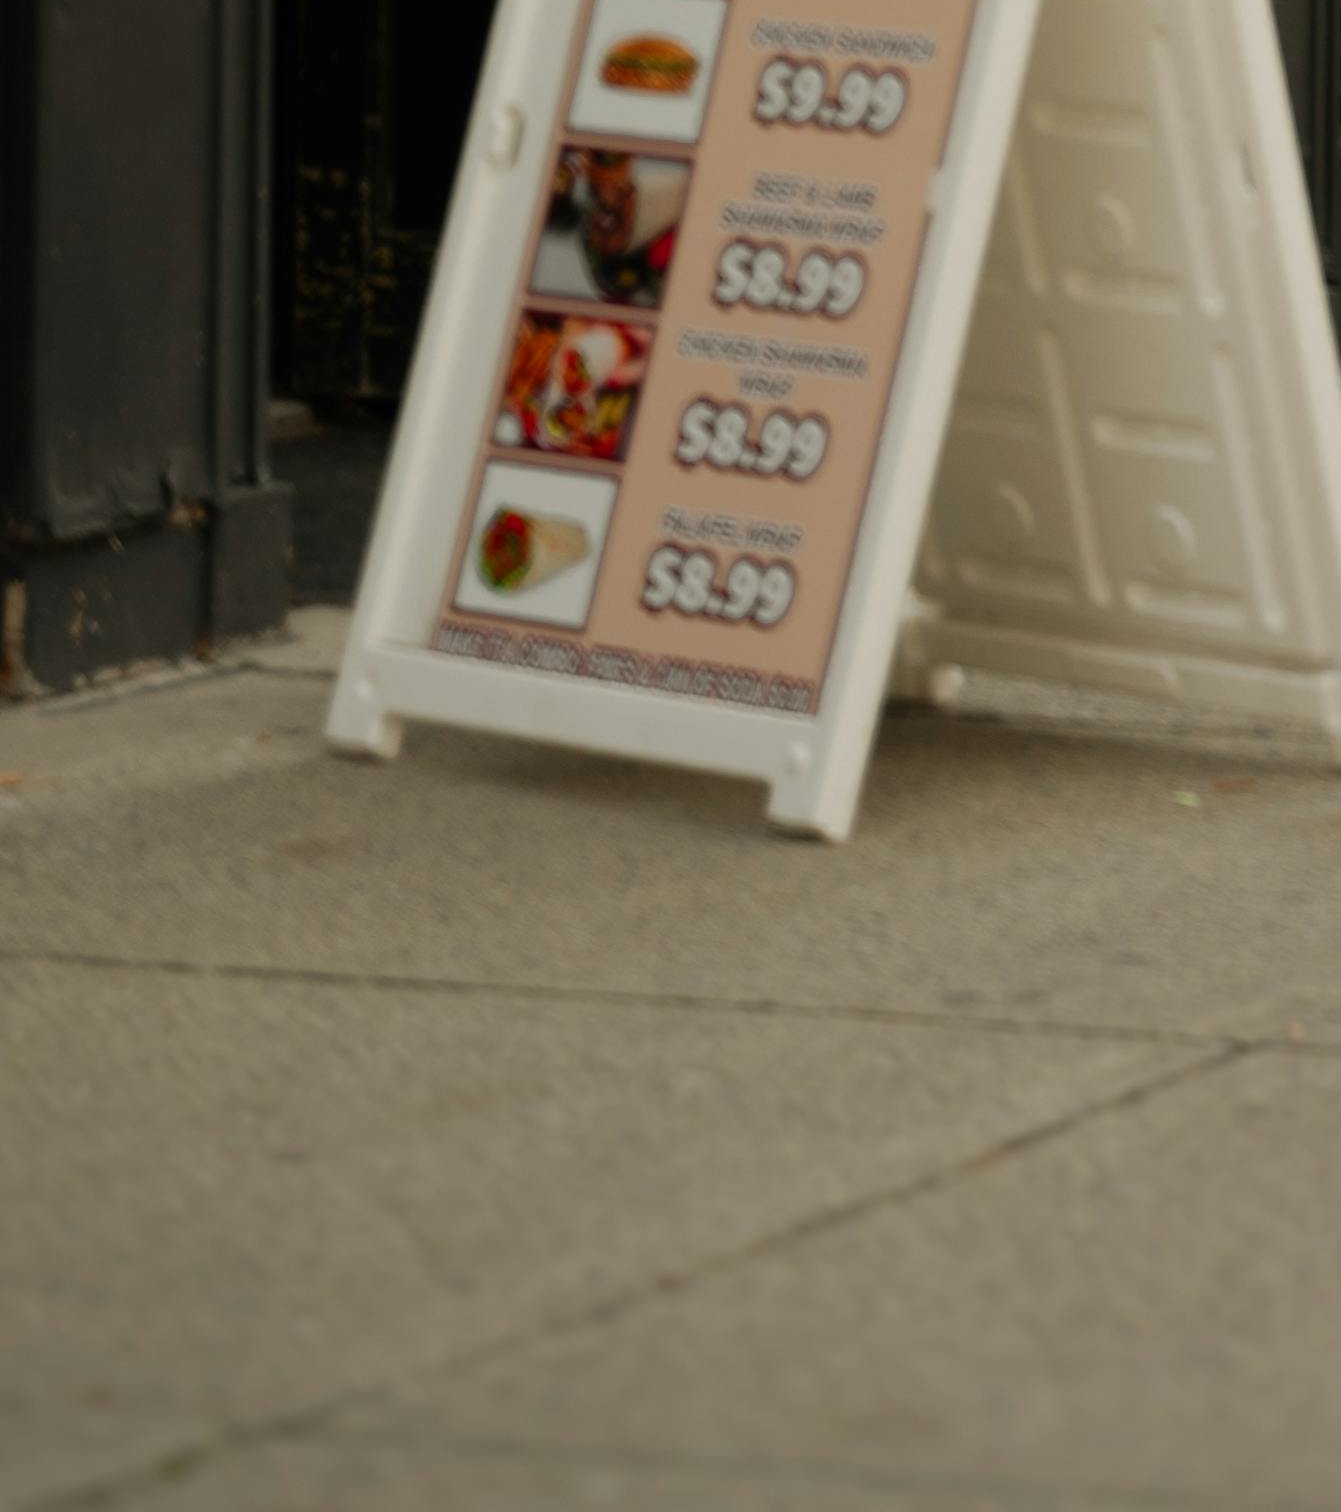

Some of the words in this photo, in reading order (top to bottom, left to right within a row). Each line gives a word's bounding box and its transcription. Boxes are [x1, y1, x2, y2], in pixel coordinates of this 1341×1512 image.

[754, 19, 835, 49] CHICKEN
[837, 25, 937, 62] SANDWICH
[754, 55, 909, 136] $9.99
[713, 235, 869, 320] $8.99
[674, 395, 831, 483] $8.99
[641, 542, 798, 630] $8.99
